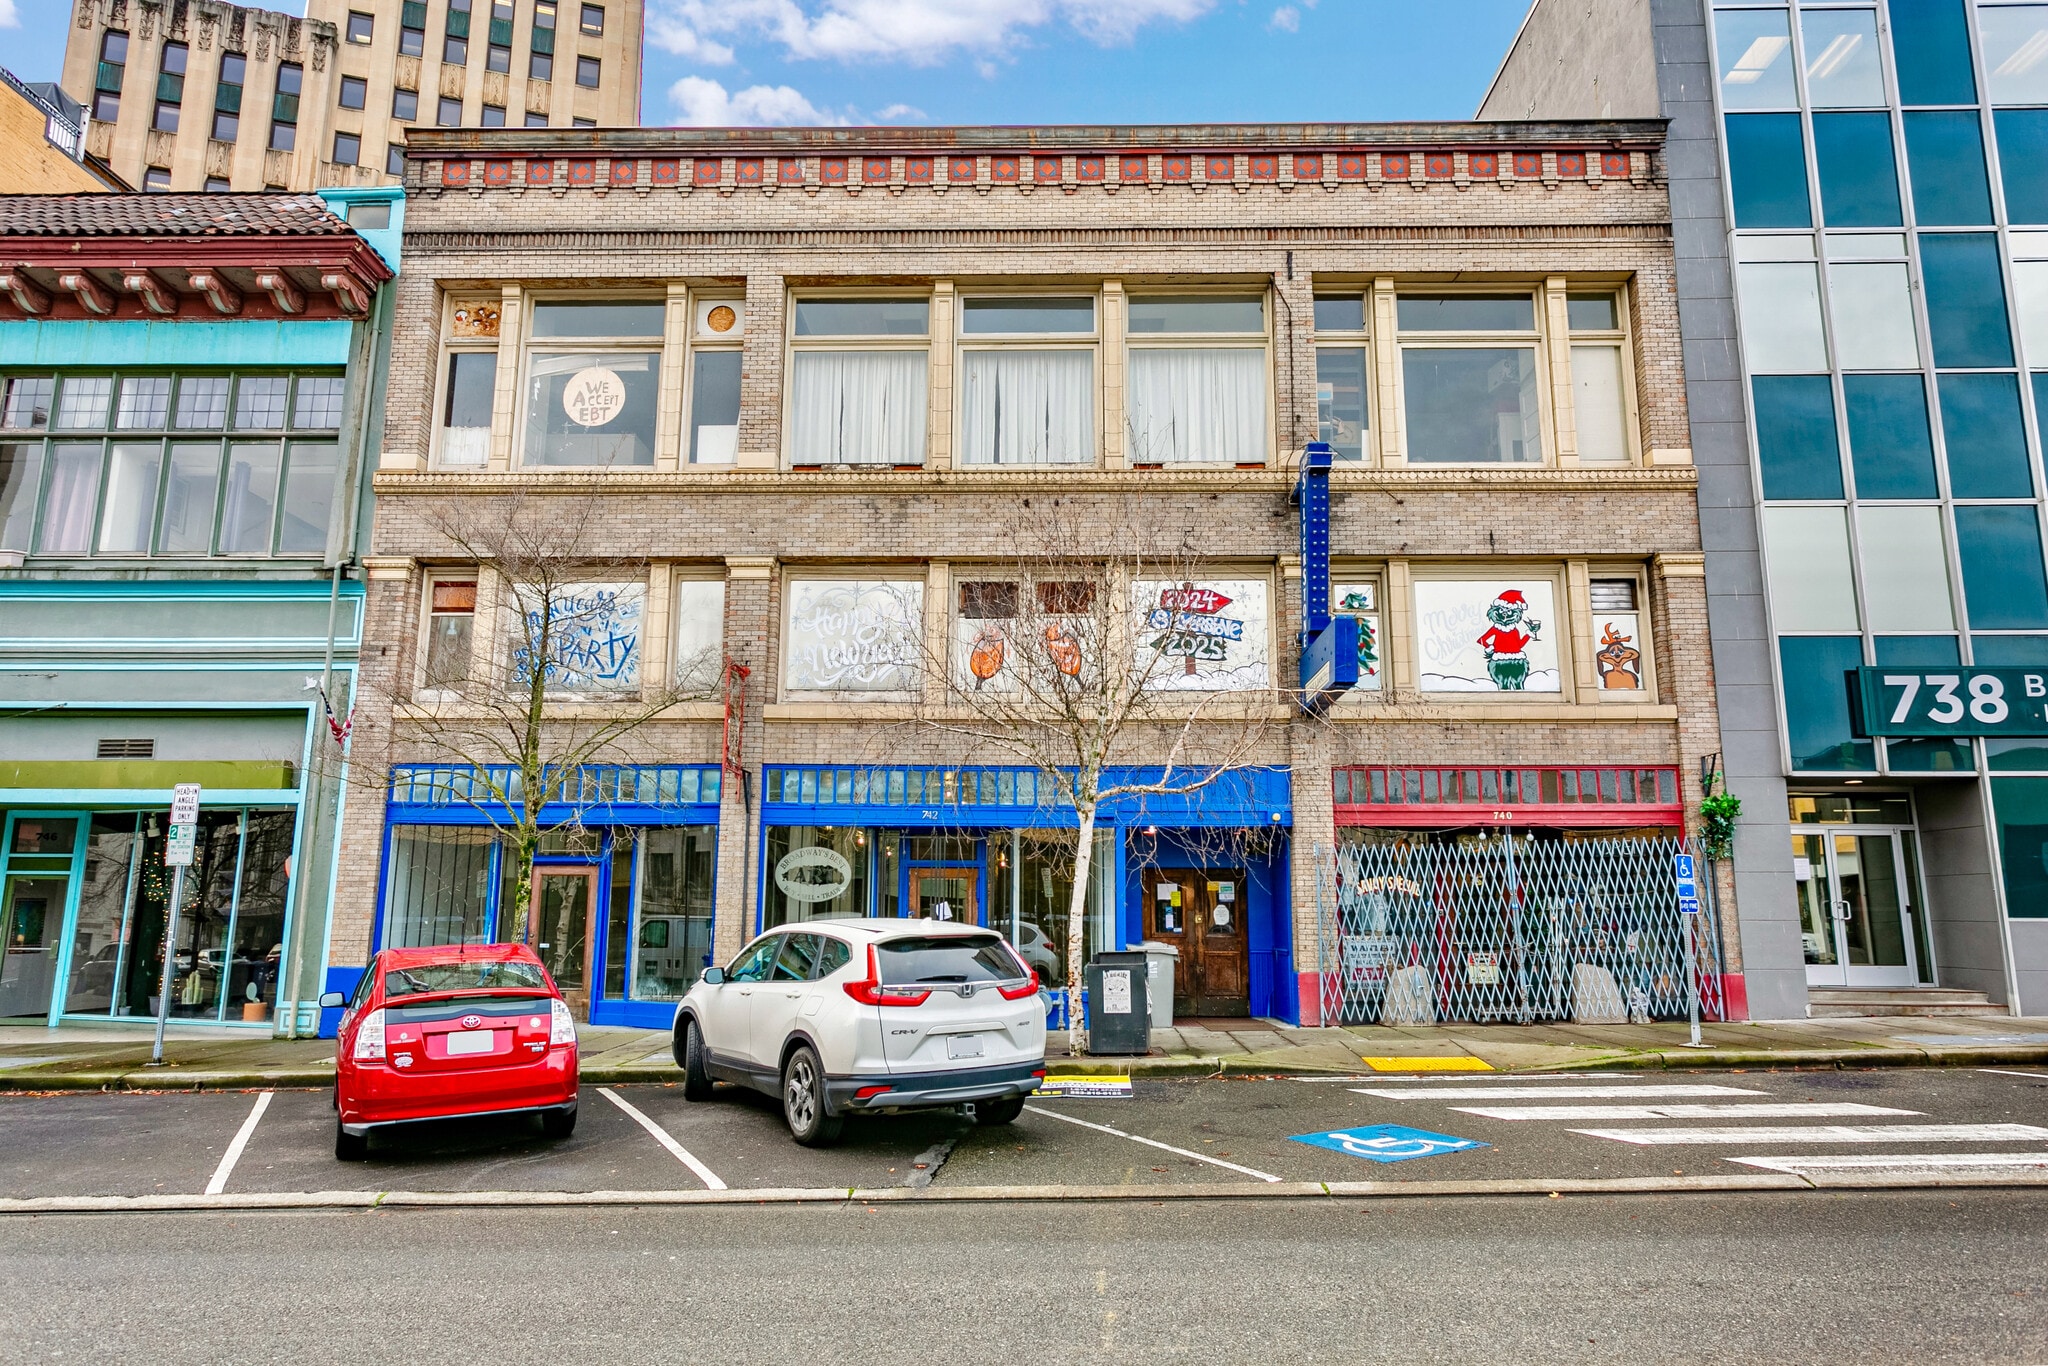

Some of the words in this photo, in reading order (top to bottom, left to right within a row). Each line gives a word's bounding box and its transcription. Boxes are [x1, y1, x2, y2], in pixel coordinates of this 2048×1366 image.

[585, 381, 609, 394] WE
[572, 390, 620, 407] ACCEPT
[579, 407, 611, 422] EBT
[1165, 590, 1219, 609] 2024
[1165, 633, 1224, 660] 2025
[559, 631, 636, 679] PARTY
[1883, 674, 2009, 724] 738
[176, 786, 198, 796] HEAD-IN
[922, 810, 939, 820] 742
[1493, 811, 1513, 820] 740
[35, 832, 59, 841] 746
[170, 827, 178, 838] 2
[780, 849, 829, 870] BROADWAY'S
[829, 853, 847, 869] BEST
[891, 1028, 919, 1036] CR-V
